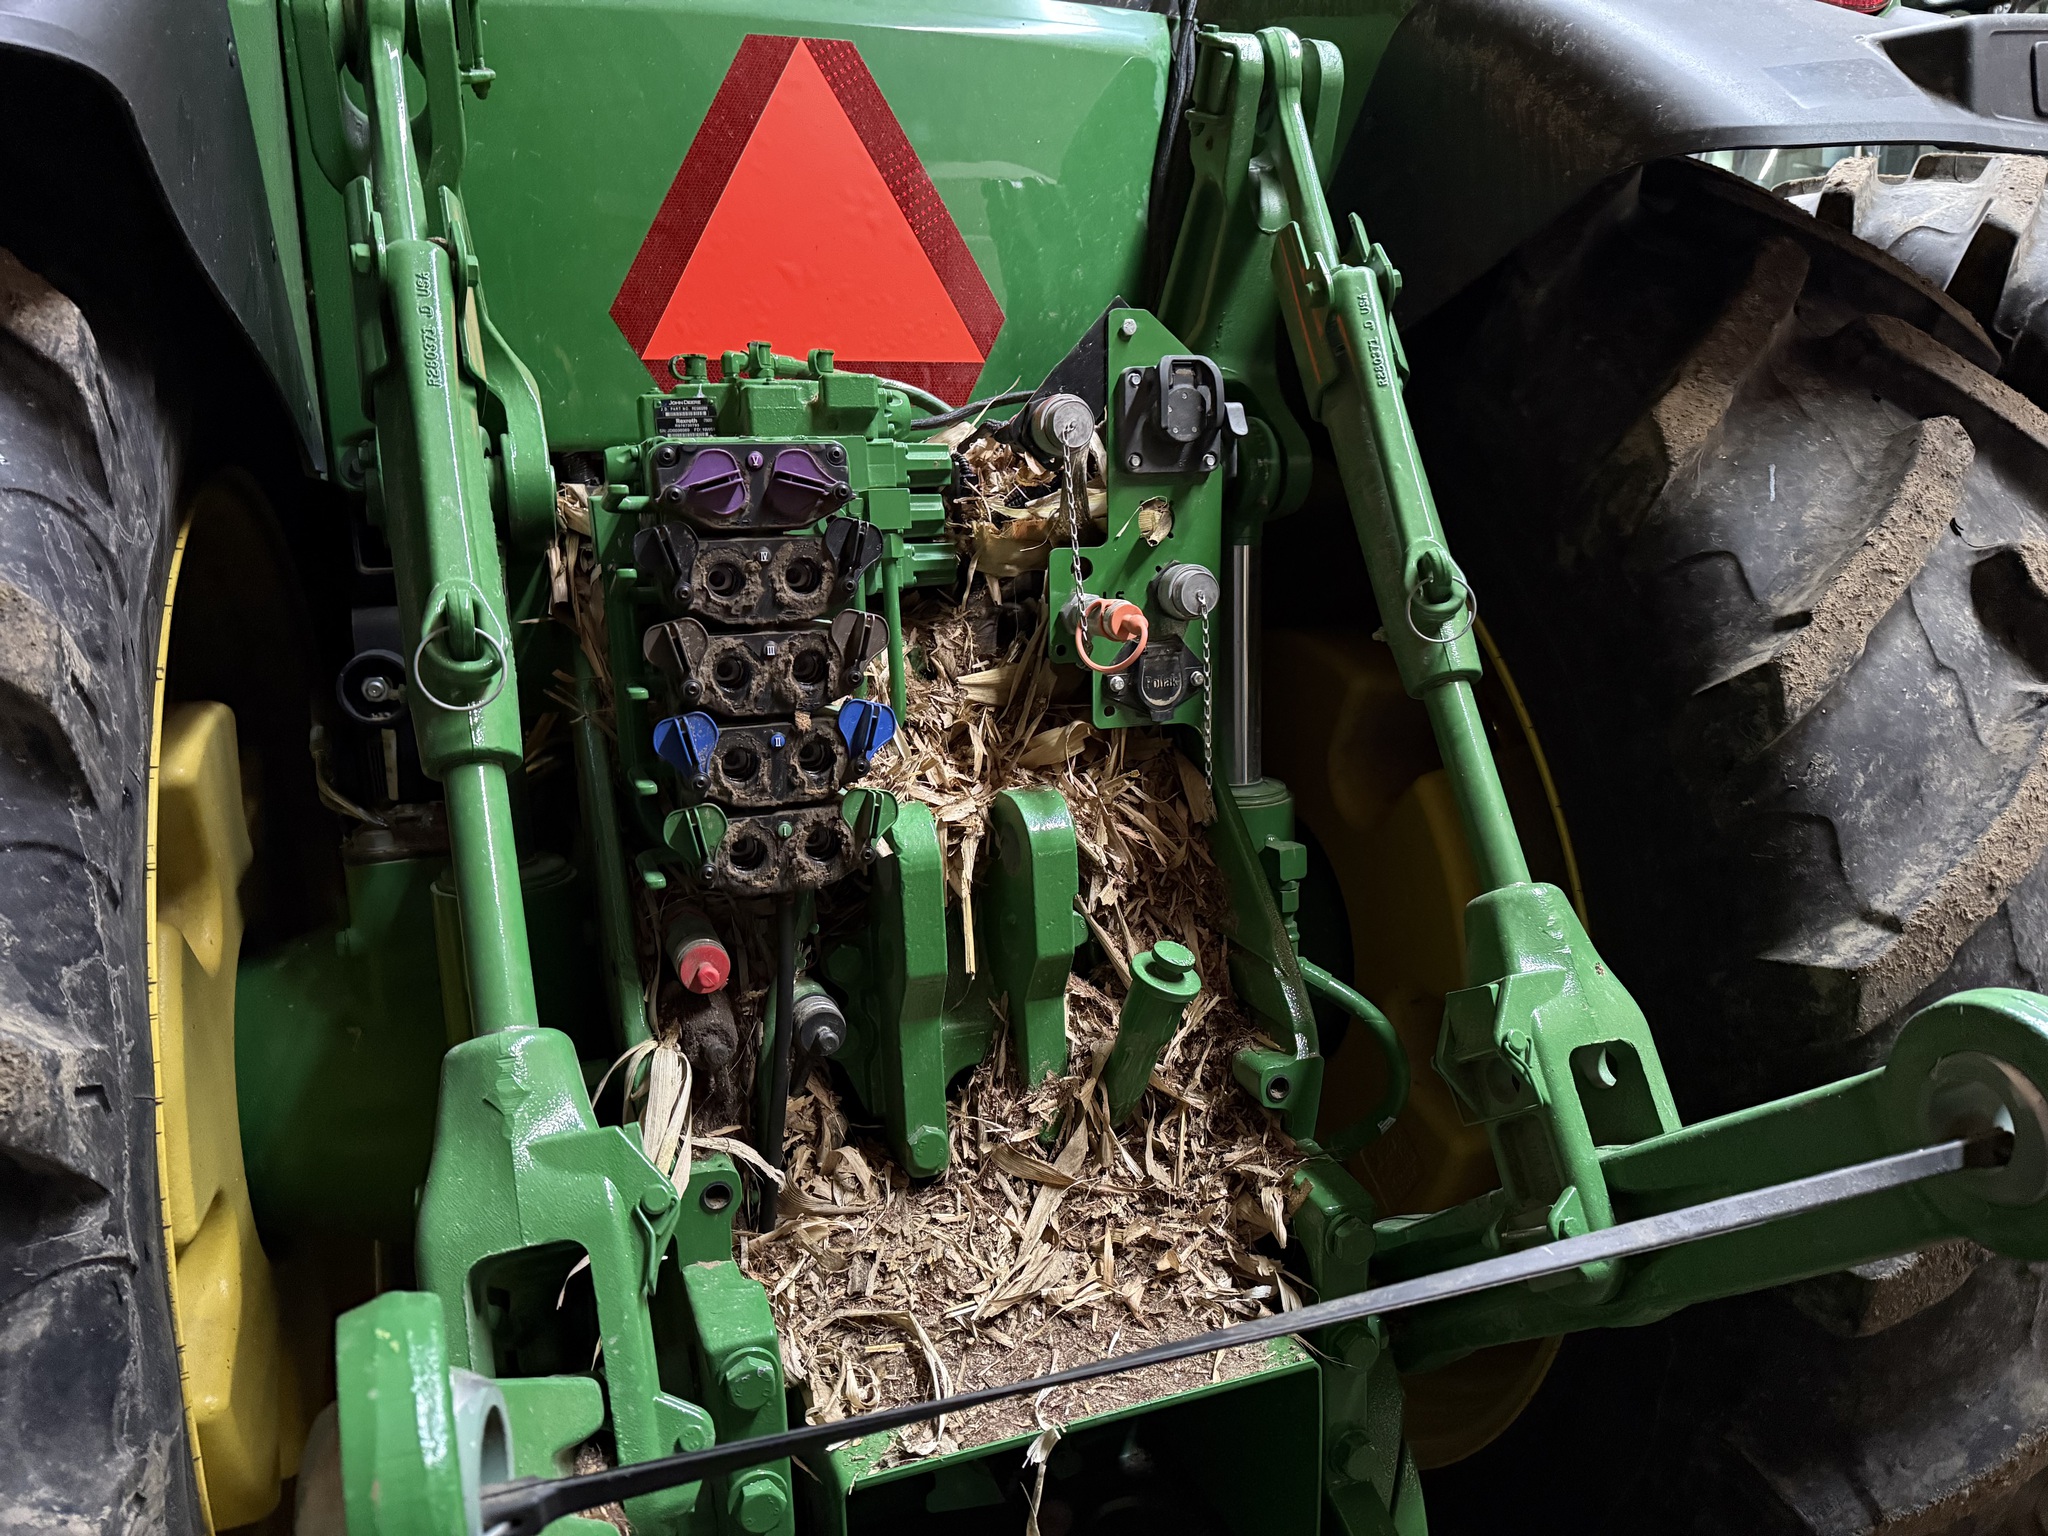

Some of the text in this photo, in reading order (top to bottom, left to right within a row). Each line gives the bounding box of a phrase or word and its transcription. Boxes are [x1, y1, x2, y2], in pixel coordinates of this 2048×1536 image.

[414, 272, 432, 297] USA
[1357, 293, 1371, 315] USA
[751, 455, 760, 467] V
[760, 551, 768, 562] IV
[1145, 674, 1179, 689] Pollak
[775, 736, 782, 747] II
